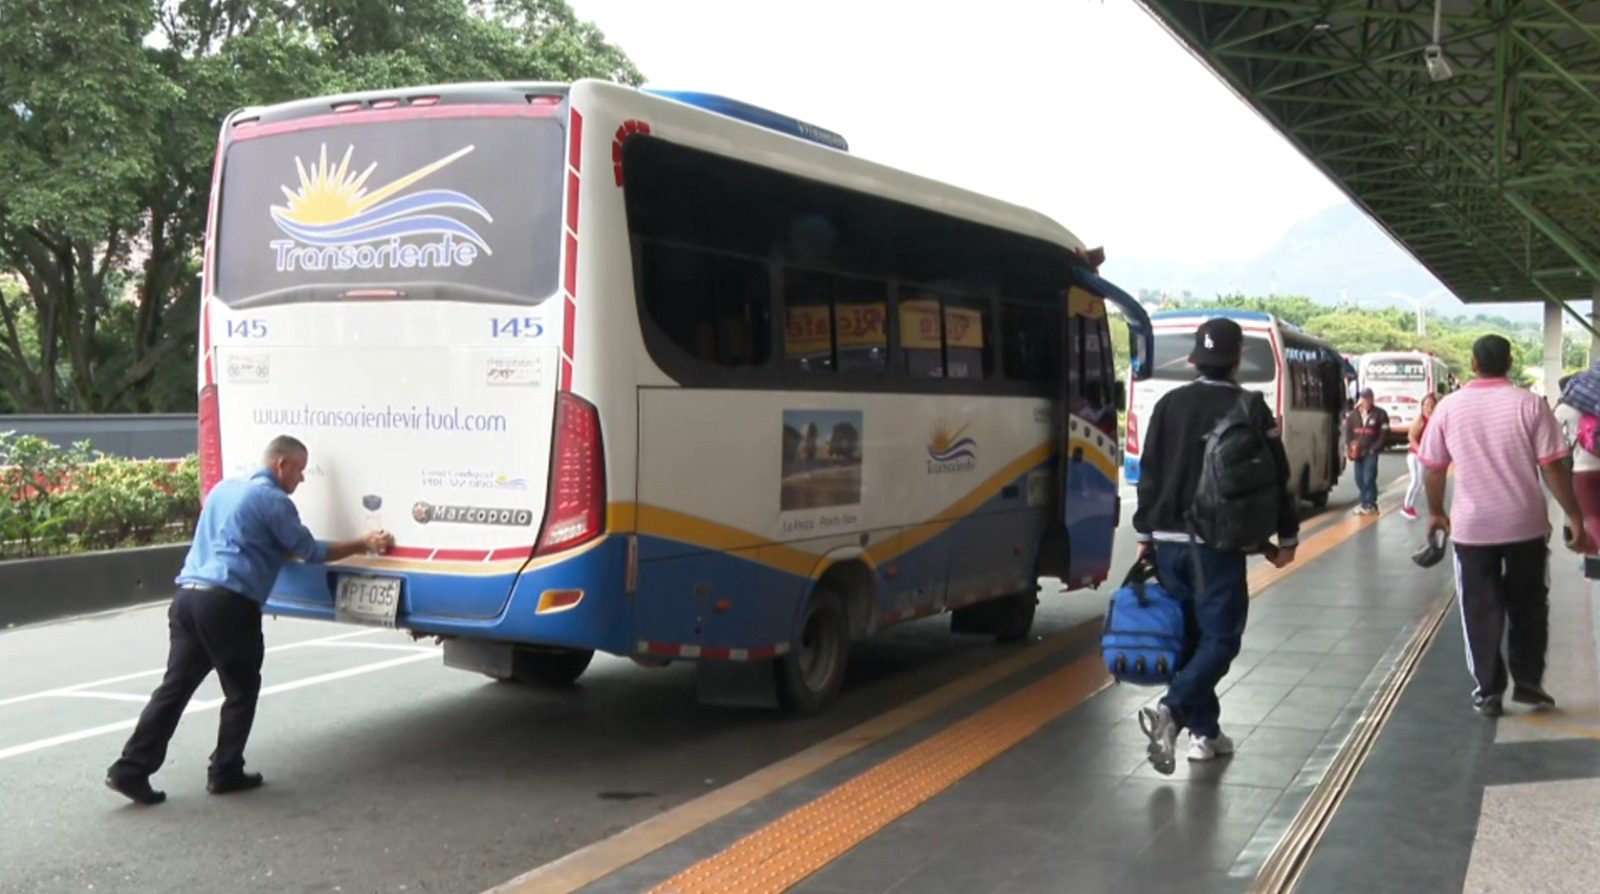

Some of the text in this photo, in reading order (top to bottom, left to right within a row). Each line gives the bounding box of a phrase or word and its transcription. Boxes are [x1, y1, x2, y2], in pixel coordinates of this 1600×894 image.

[269, 232, 478, 271] Transoriente
[225, 319, 267, 338] 145
[490, 317, 544, 338] 145
[253, 404, 507, 433] www.transorientevirtual.com
[432, 505, 528, 524] Marcopolo
